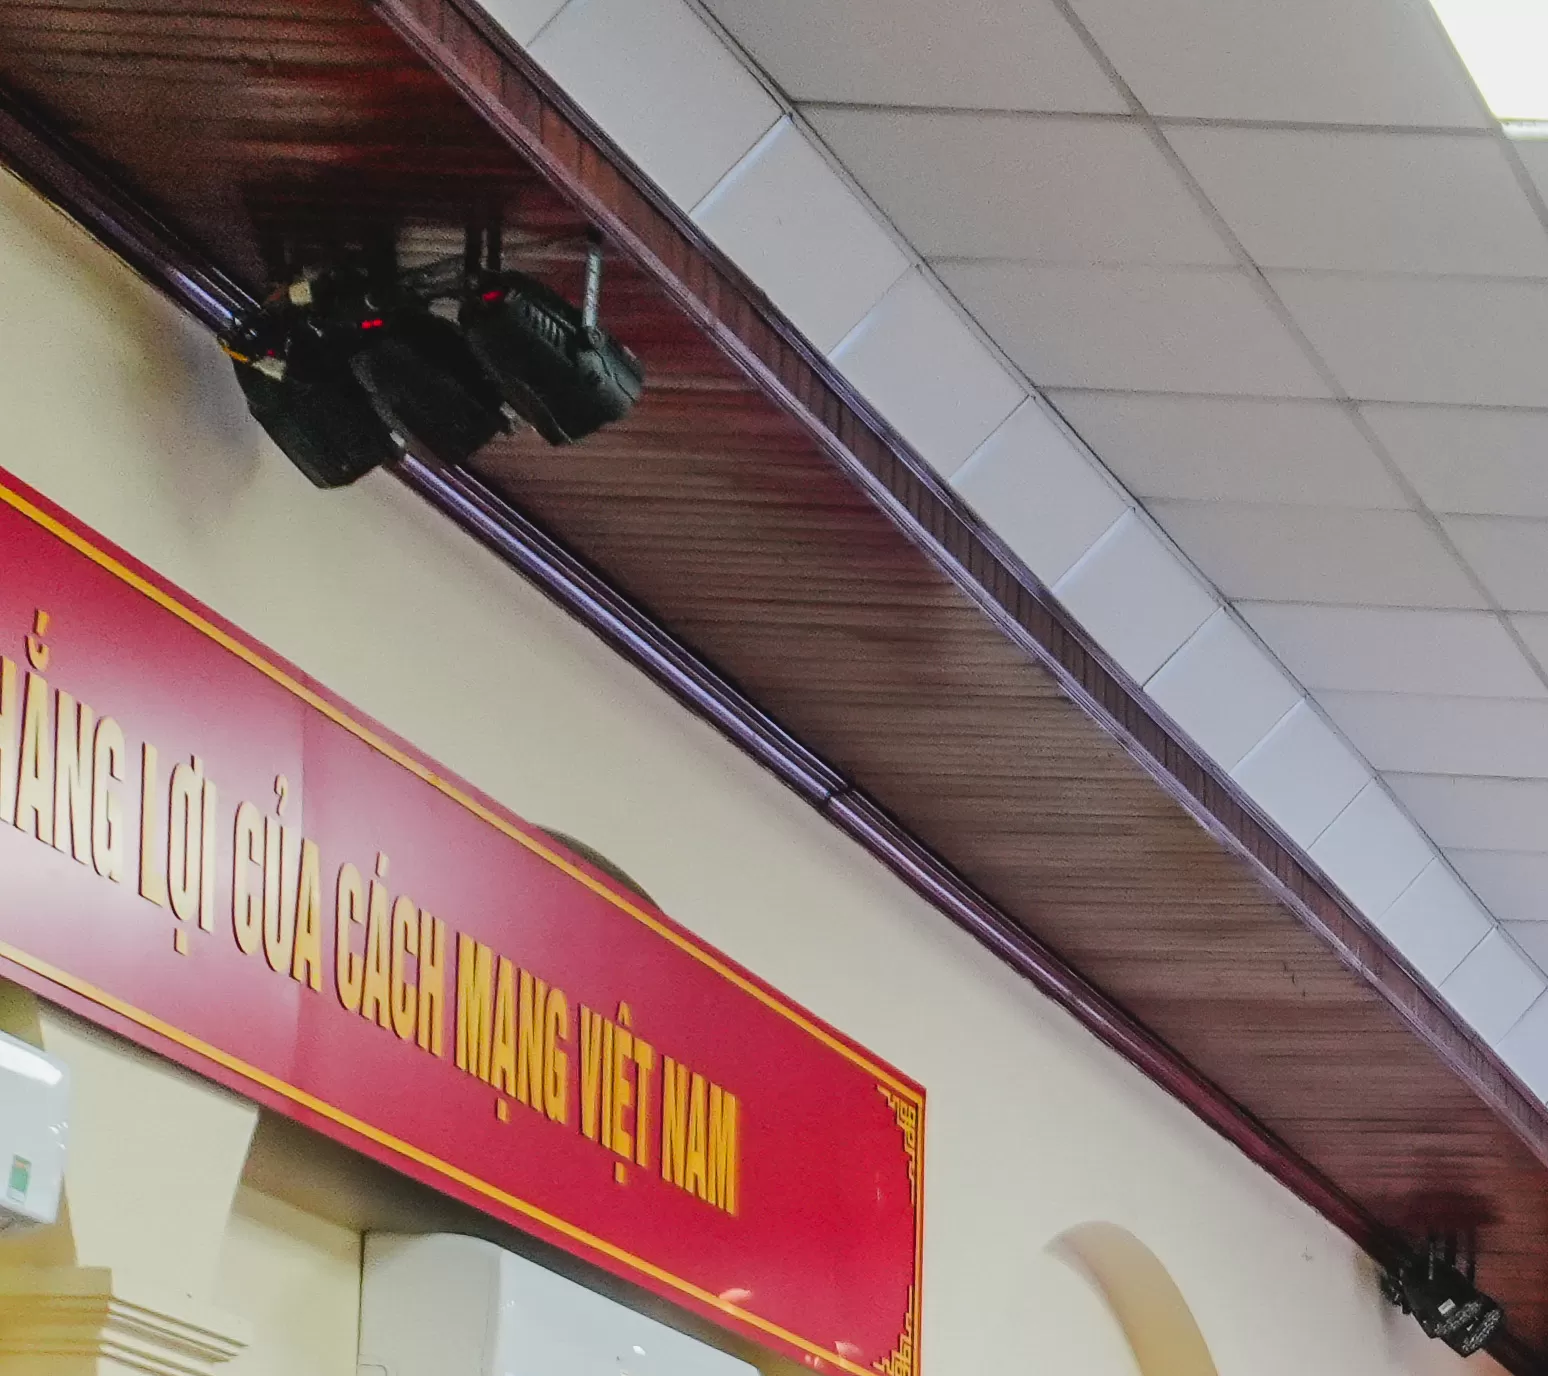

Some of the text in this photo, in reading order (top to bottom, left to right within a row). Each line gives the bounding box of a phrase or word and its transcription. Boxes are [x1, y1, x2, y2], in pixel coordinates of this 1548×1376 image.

[139, 741, 216, 956] LỢI
[231, 773, 323, 994] CỦA
[334, 851, 445, 1057] CÁCH
[454, 932, 568, 1124] MẠNG
[578, 1000, 654, 1184] VIỆT
[662, 1054, 739, 1217] NAM
